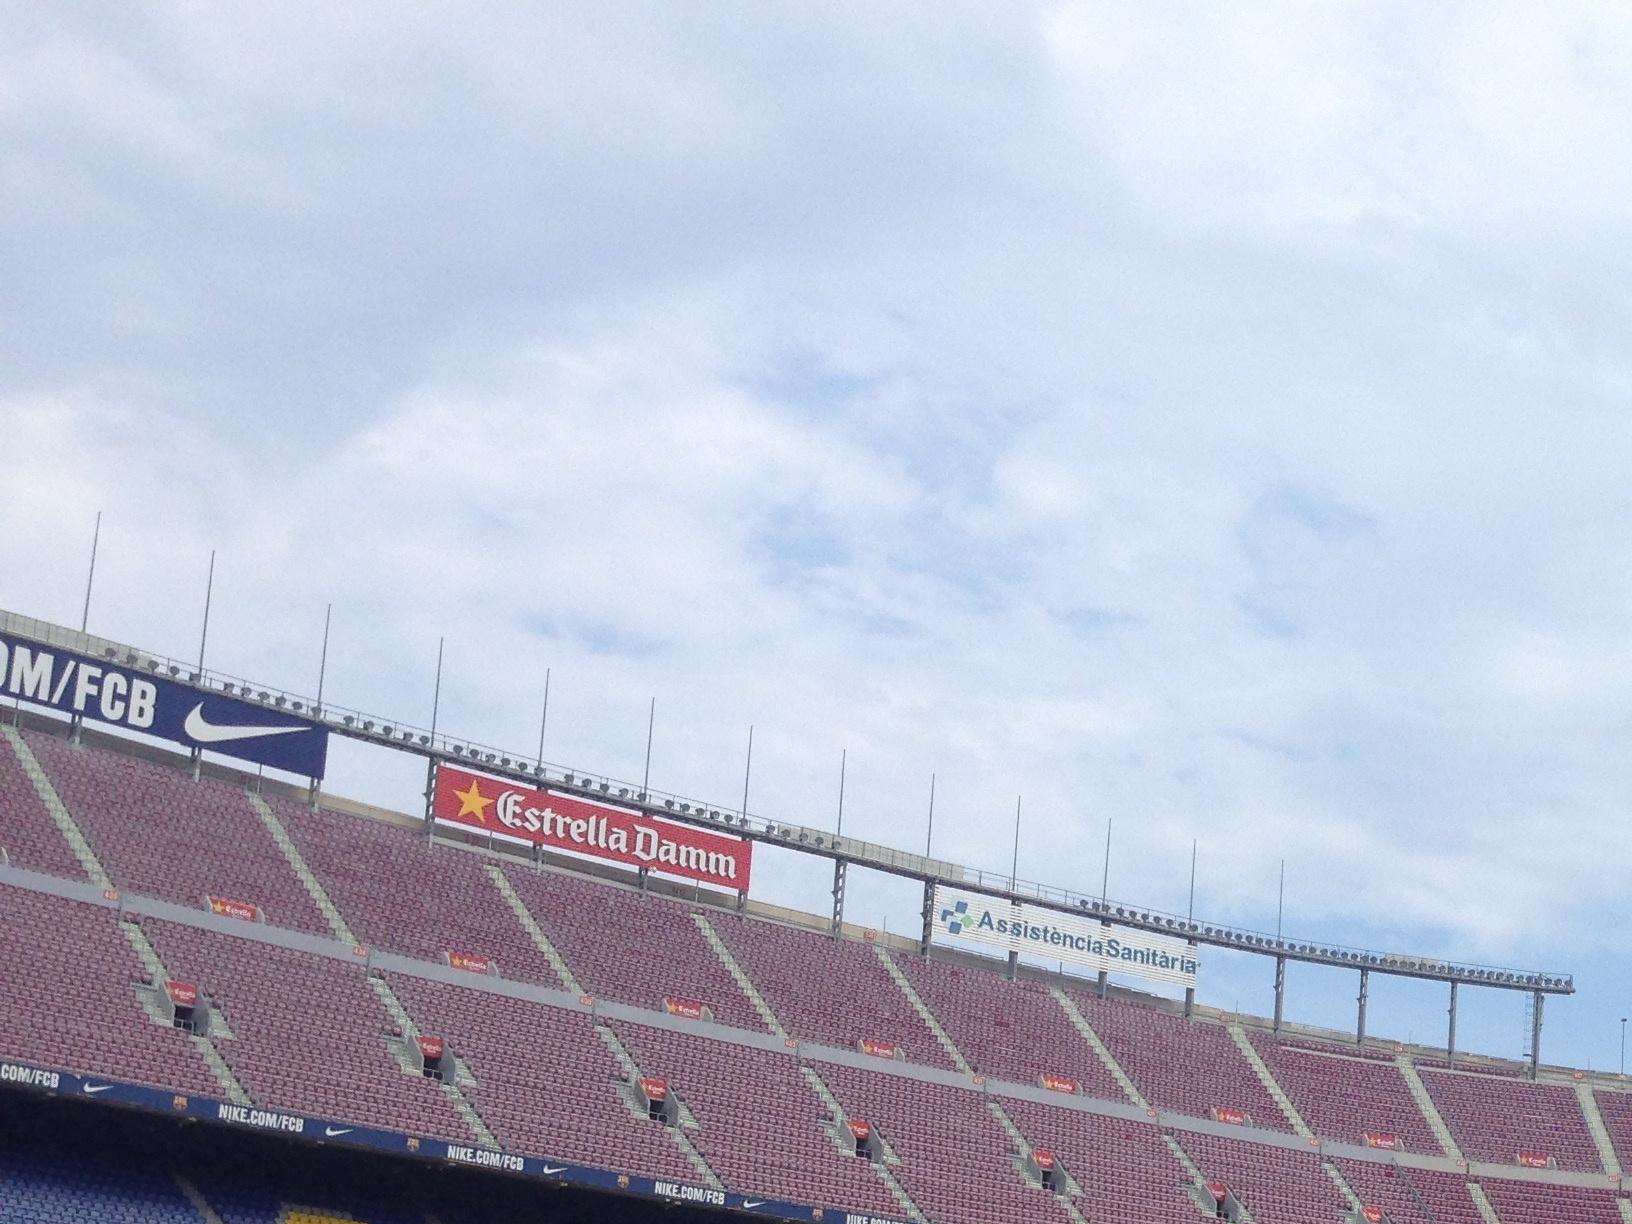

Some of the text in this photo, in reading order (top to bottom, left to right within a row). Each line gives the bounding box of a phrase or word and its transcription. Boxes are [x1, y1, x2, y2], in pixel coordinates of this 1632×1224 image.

[496, 790, 737, 880] Estrella Damm
[978, 910, 1196, 975] Assistència Sanitària
[218, 1103, 304, 1132] NIKE.COM/FCB
[447, 1144, 525, 1171] NIKE.COM/FCB
[654, 1181, 726, 1205] NIKE.COM/FCB
